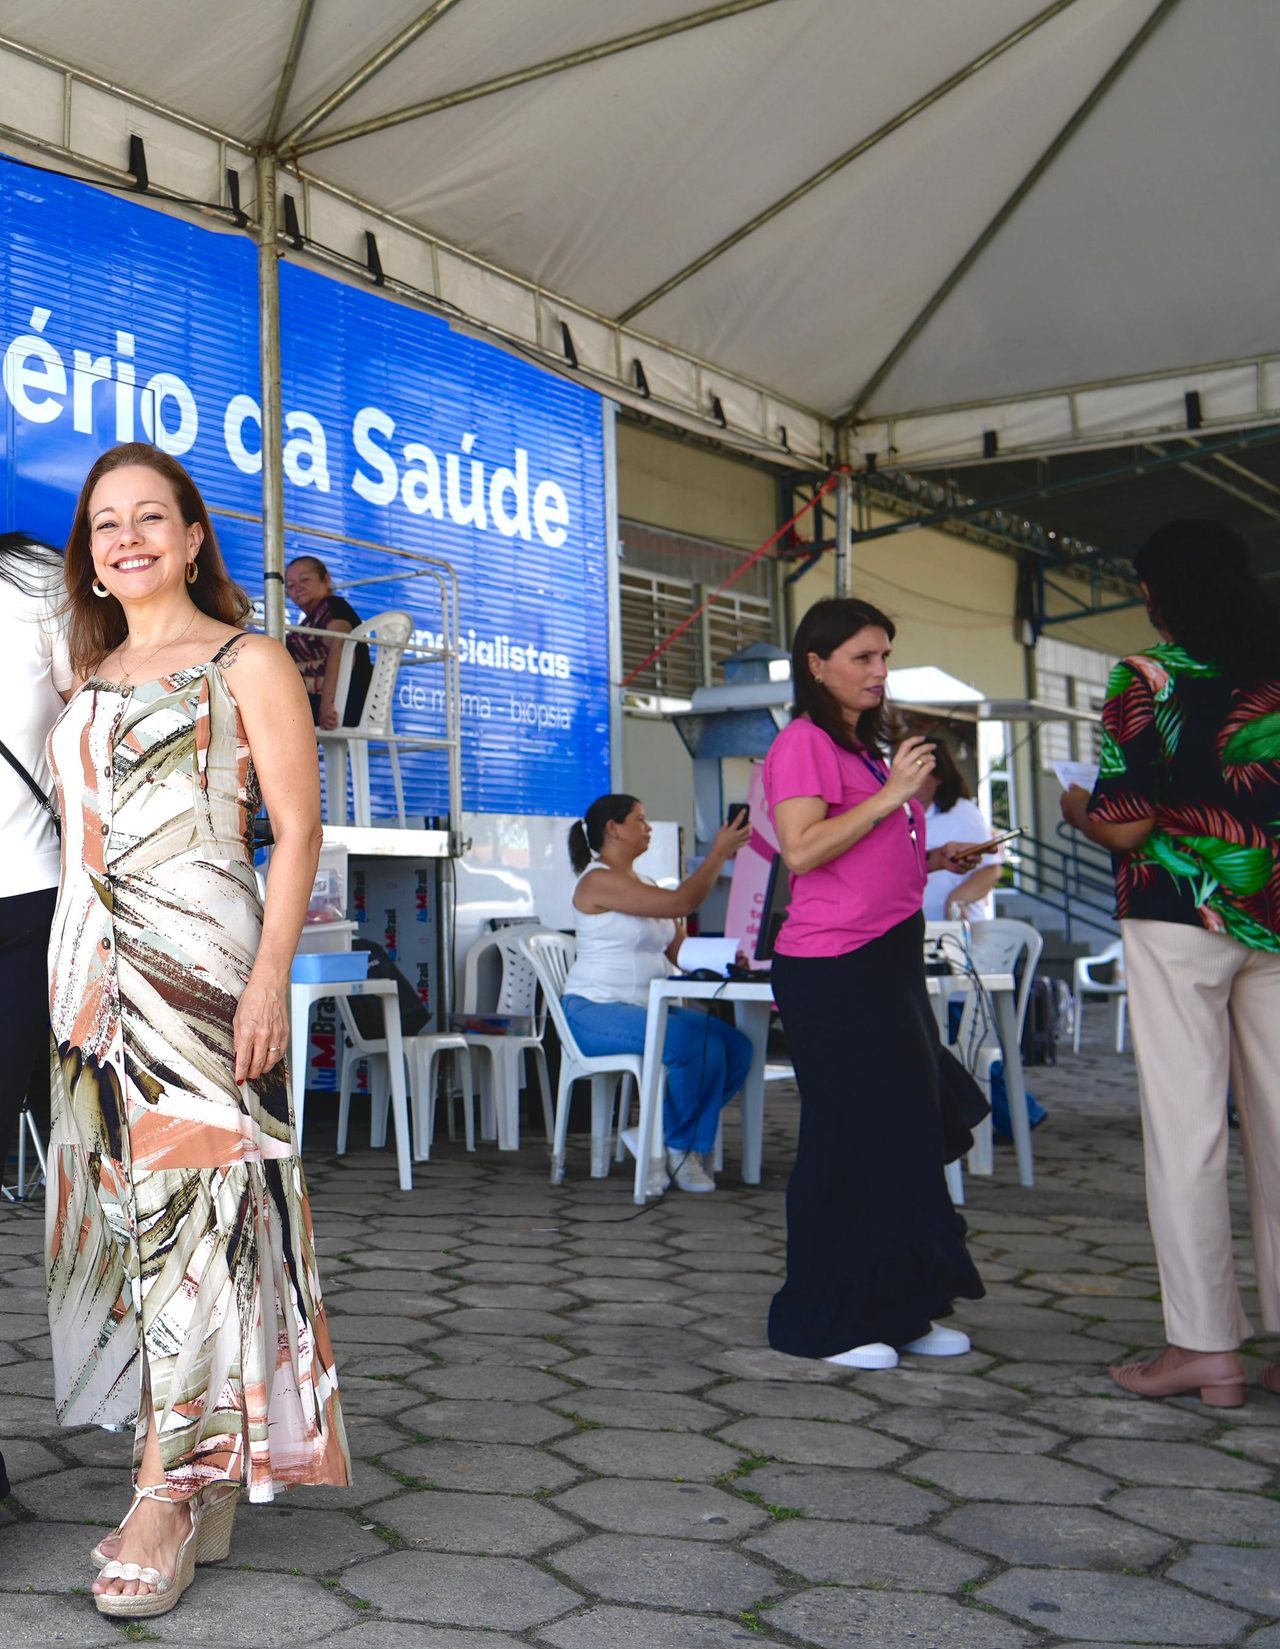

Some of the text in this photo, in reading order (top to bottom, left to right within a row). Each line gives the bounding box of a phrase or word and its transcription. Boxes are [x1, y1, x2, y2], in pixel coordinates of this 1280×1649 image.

[351, 406, 569, 548] Saúde
[399, 678, 426, 710] de
[432, 687, 491, 718] mma
